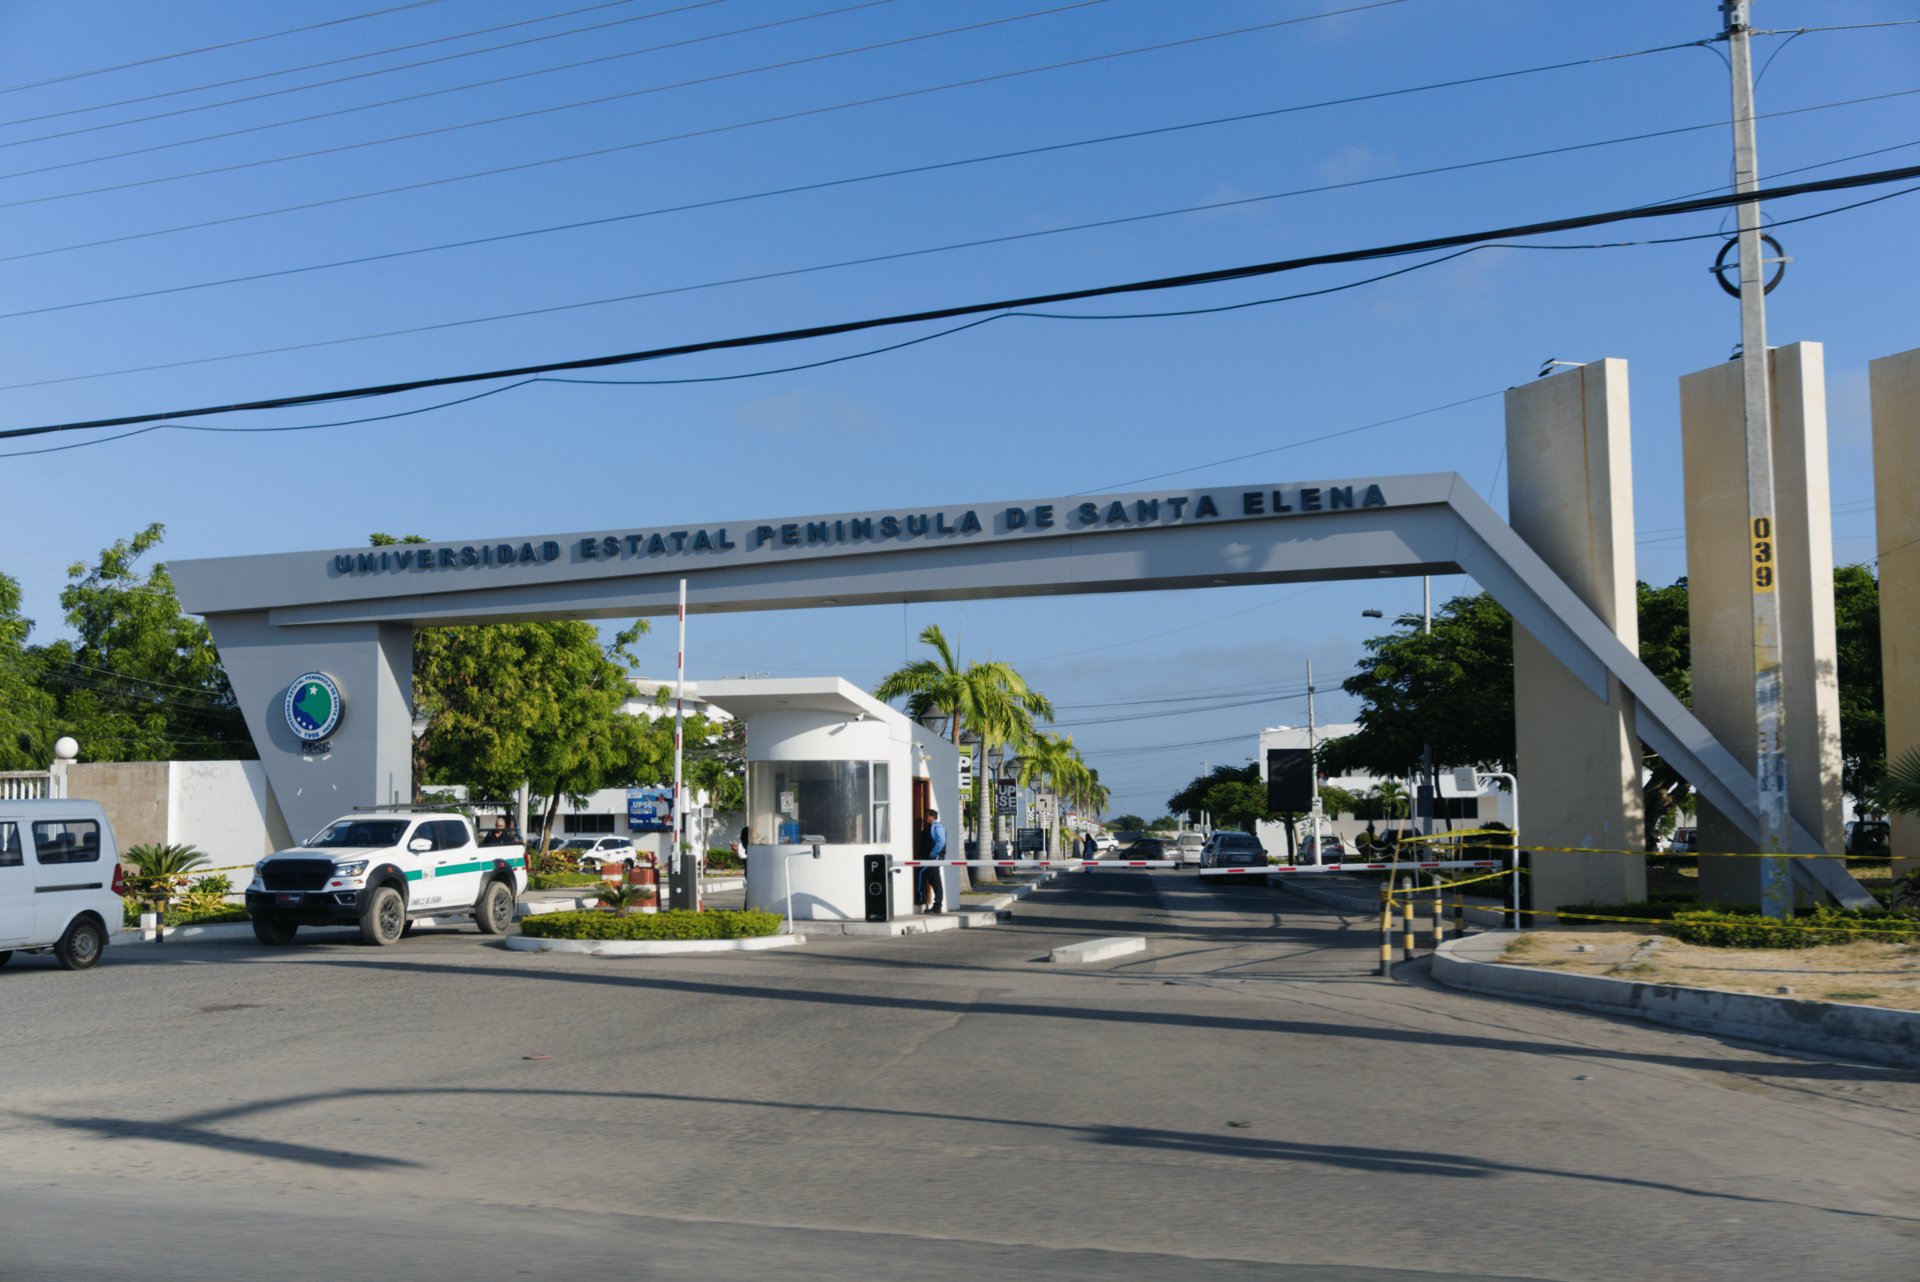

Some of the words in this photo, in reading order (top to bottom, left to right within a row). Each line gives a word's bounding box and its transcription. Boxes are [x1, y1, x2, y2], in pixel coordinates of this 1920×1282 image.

[335, 541, 561, 573] UNIVERSIDAD
[580, 528, 735, 558] ESTATAL
[757, 510, 983, 546] PENINSULA
[1006, 505, 1055, 529] DE
[1078, 495, 1219, 524] SANTA
[1243, 484, 1387, 515] ELENA
[1754, 517, 1773, 588] 039
[288, 677, 304, 698] ESTATAL
[286, 699, 302, 735] UNIVERSIDAD
[322, 717, 336, 734] ELENA
[998, 784, 1017, 797] UP
[633, 801, 653, 809] UPSE
[999, 795, 1017, 808] SE
[871, 861, 879, 872] P
